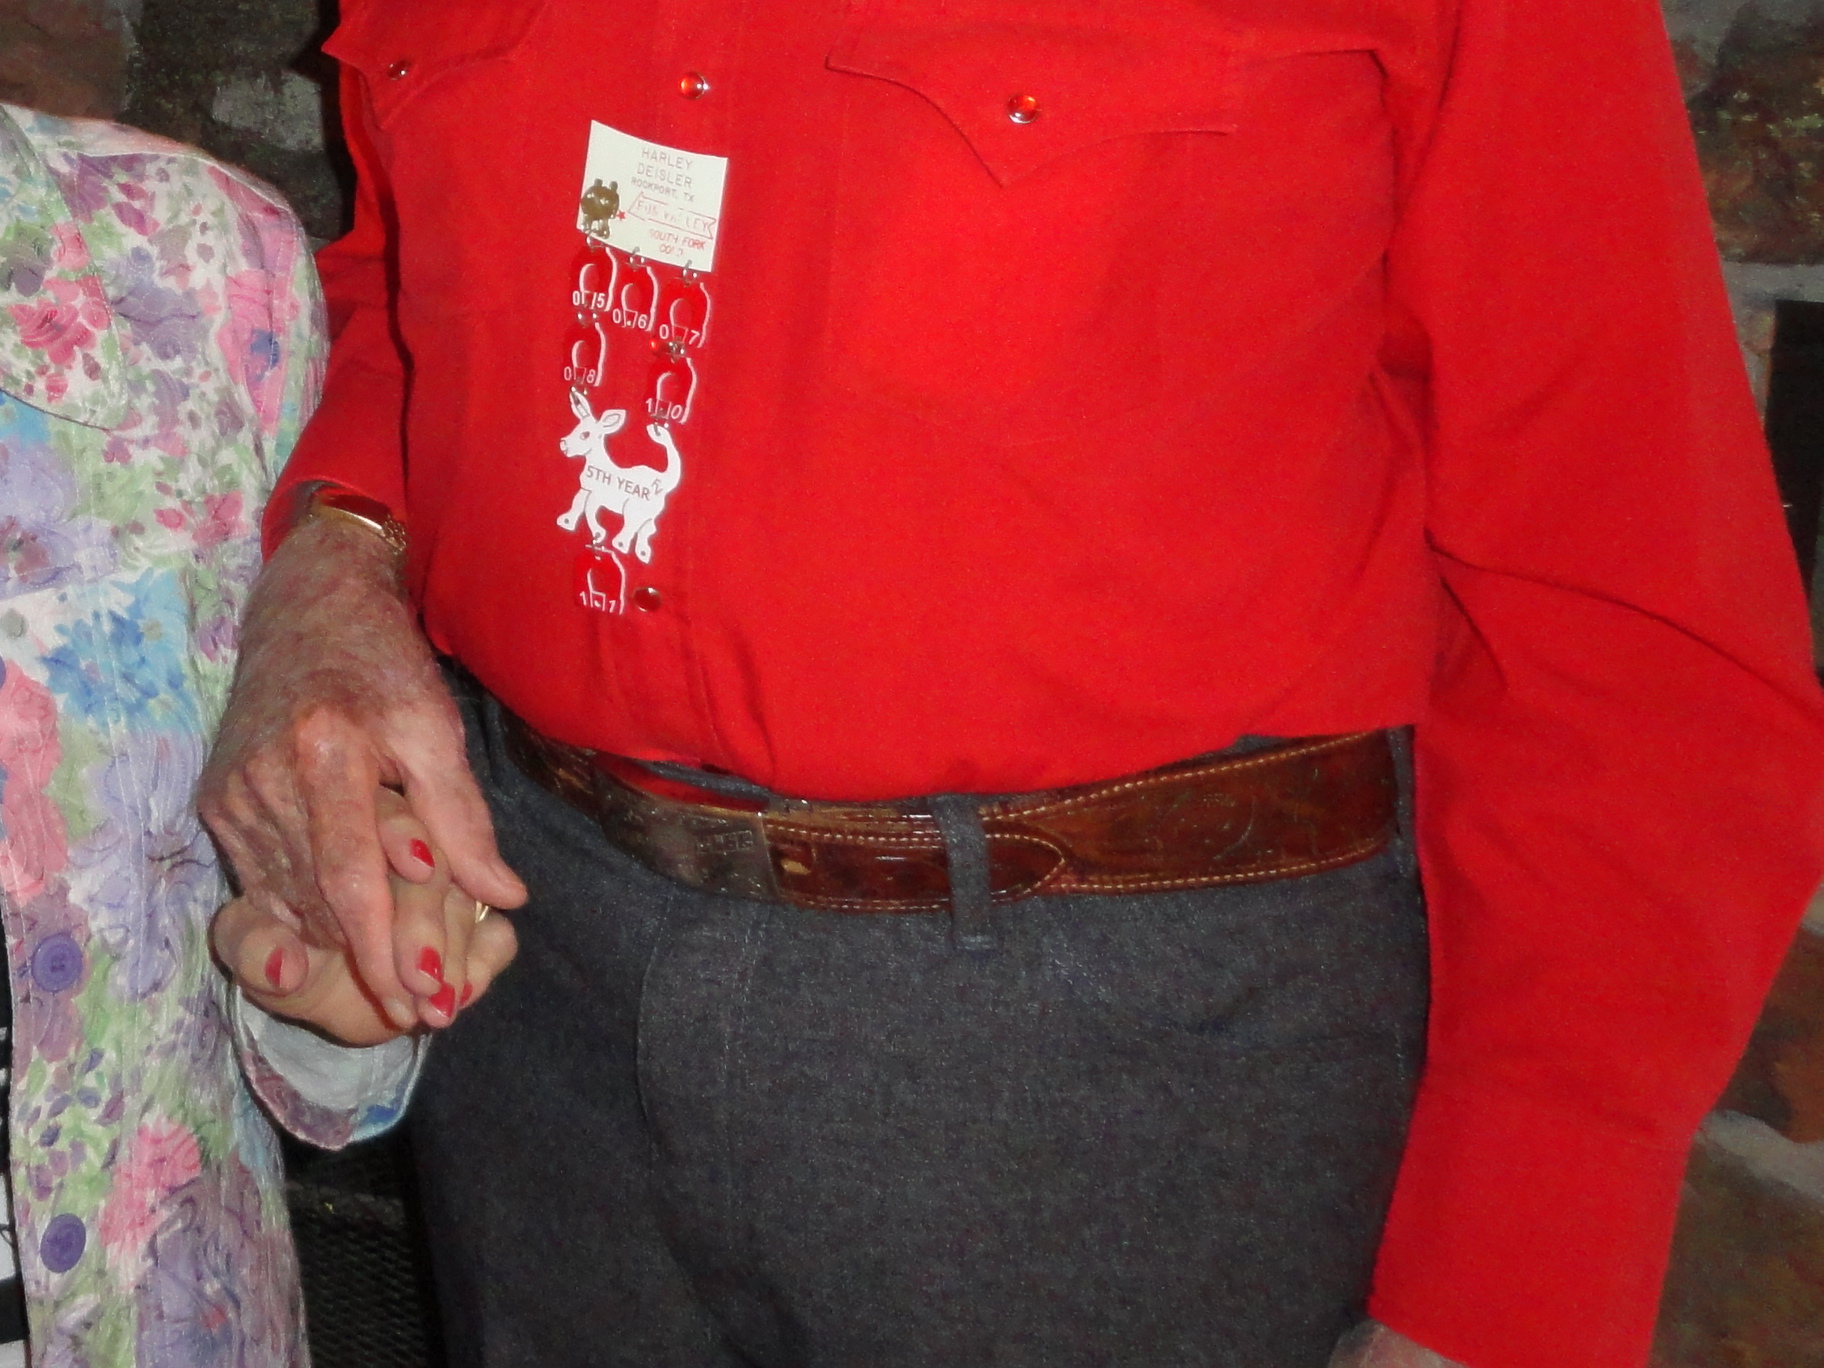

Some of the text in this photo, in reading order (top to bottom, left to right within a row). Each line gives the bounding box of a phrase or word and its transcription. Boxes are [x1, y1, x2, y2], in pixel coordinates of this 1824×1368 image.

[642, 148, 693, 170] HARLEY
[637, 162, 692, 188] DEISLER
[684, 192, 695, 203] TX
[649, 228, 706, 250] SOUTH FORK
[586, 465, 650, 502] 5TH YEAR
